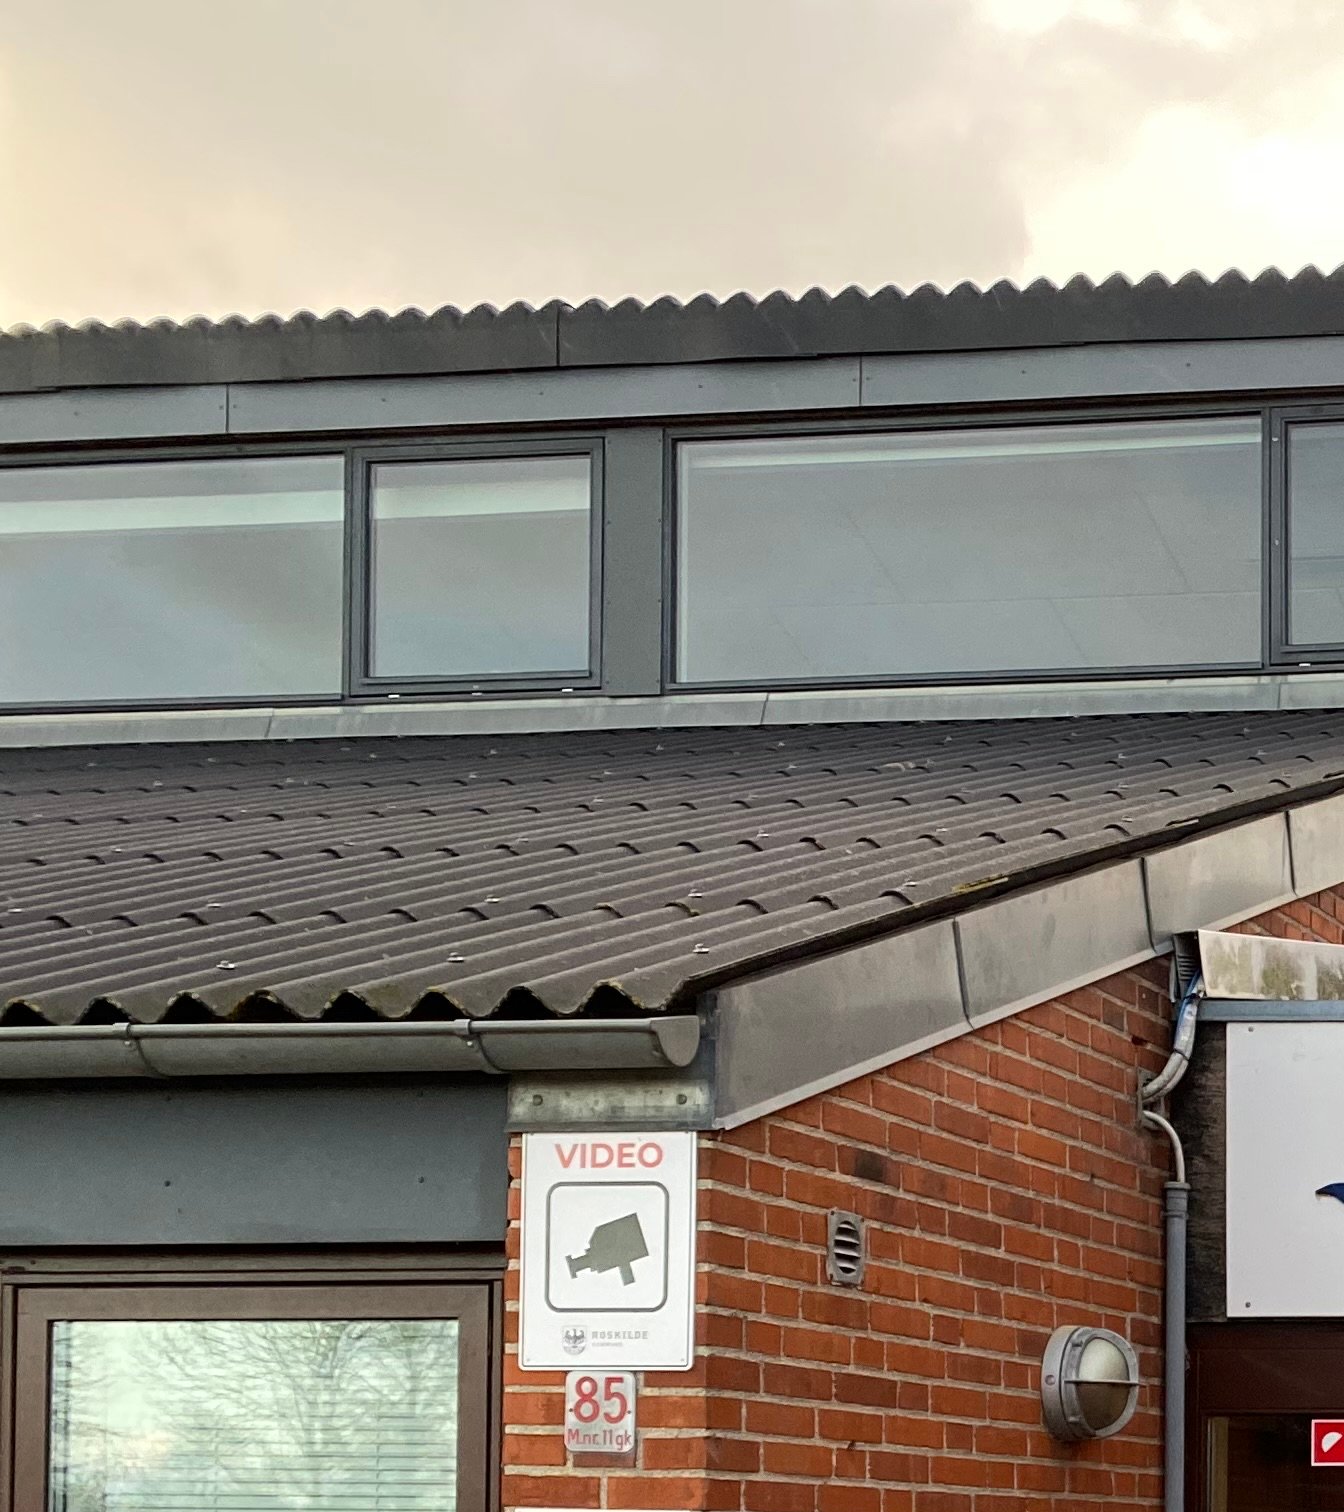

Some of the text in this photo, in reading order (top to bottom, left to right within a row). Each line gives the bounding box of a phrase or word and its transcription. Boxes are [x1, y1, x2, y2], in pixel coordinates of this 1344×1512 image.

[554, 1142, 664, 1169] VIDEO
[591, 1330, 649, 1340] ROSKILDE
[573, 1376, 628, 1424] 85
